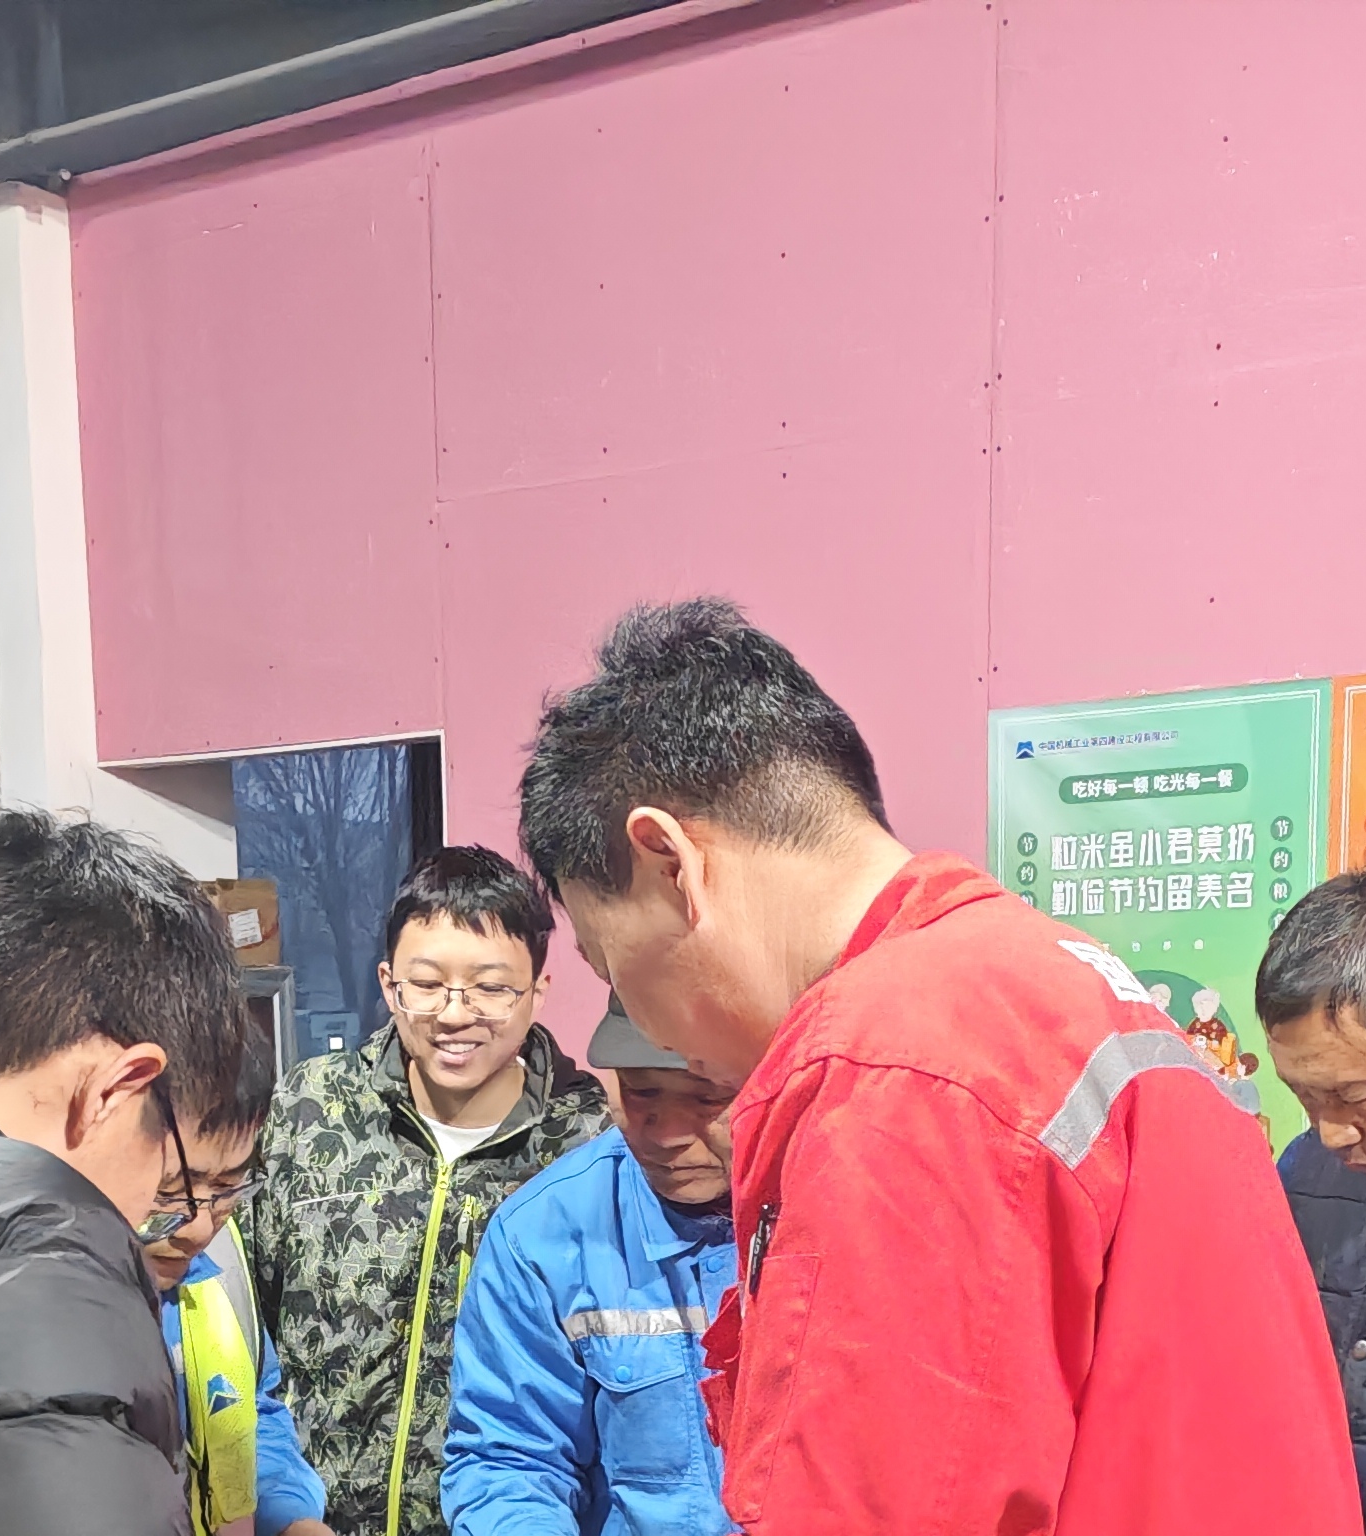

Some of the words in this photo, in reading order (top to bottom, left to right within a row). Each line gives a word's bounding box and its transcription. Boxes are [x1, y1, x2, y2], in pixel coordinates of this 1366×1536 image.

[1072, 776, 1149, 799] 吃好每一顿
[1153, 769, 1233, 793] 吃光每一餐
[1050, 822, 1255, 871] 粒米虽小君莫扔
[1051, 872, 1255, 917] 勤俭节约留美名
